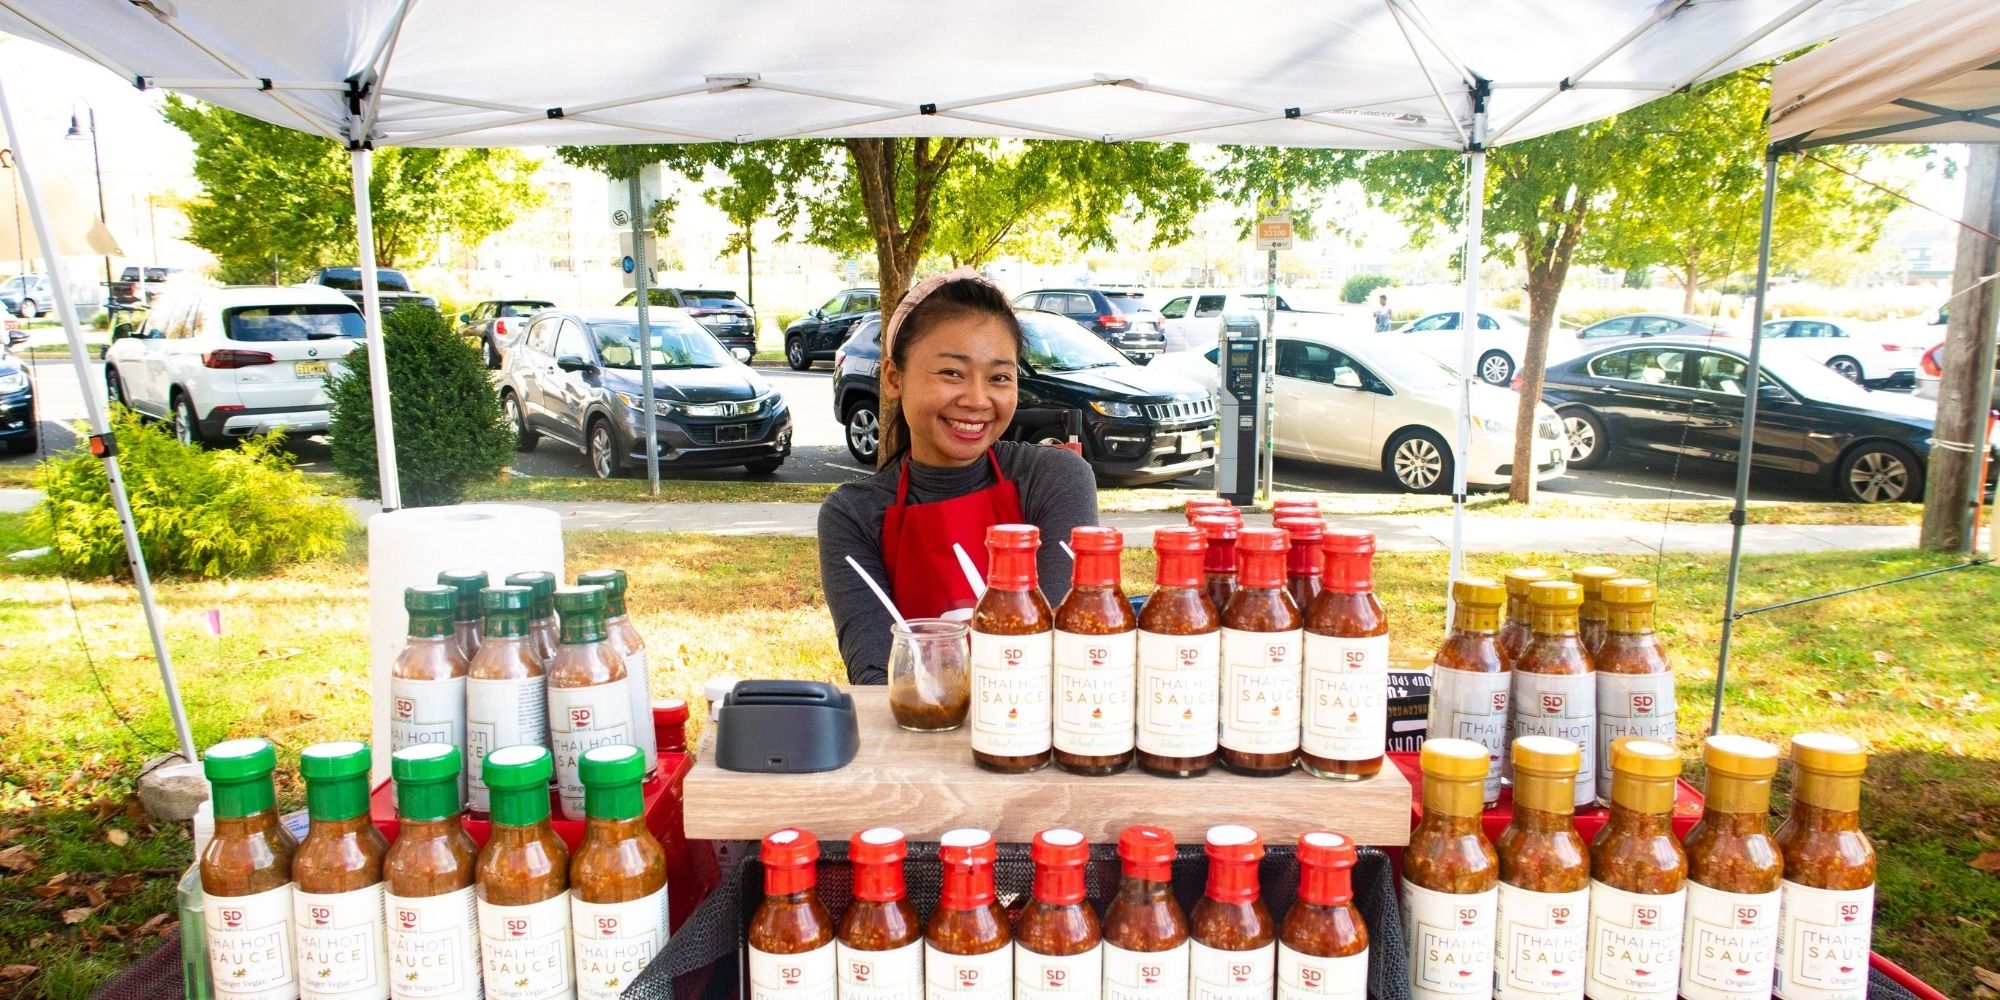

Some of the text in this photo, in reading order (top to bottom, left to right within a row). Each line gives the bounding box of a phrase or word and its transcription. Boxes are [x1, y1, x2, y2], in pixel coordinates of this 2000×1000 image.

[1004, 649, 1022, 659] SD
[1088, 648, 1108, 658] SD
[1180, 650, 1198, 660] SD
[1269, 646, 1286, 656] SD
[1346, 652, 1365, 662] SD
[980, 674, 1012, 689] THAI
[1064, 674, 1097, 689] THAI
[1152, 676, 1188, 689] THAI
[1239, 674, 1276, 688] THAI
[1317, 679, 1354, 692] THAI
[982, 690, 1044, 705] SAUCE
[1065, 690, 1128, 705] SAUCE
[1154, 690, 1216, 706] SAUCE
[1494, 694, 1506, 704] SD
[1543, 696, 1562, 707] SD
[1634, 696, 1653, 707] SD
[398, 700, 412, 712] SD
[1388, 704, 1428, 718] NNERWARE
[571, 710, 590, 720] SD
[1463, 722, 1497, 734] THAI
[1518, 721, 1588, 738] THAI HOT
[1607, 724, 1642, 736] THAI
[408, 732, 441, 743] HOT
[554, 734, 620, 752] THAI HOT
[223, 911, 242, 920] SD
[312, 908, 330, 918] SD
[1459, 909, 1478, 919] SD
[1552, 908, 1570, 918] SD
[1637, 908, 1657, 919] SD
[1737, 908, 1757, 919] SD
[1841, 904, 1858, 915] SD
[400, 911, 416, 922] SD
[508, 920, 526, 930] SD
[598, 918, 618, 928] SD
[241, 932, 277, 948] HOT
[327, 932, 363, 948] HOT
[1427, 934, 1466, 949] THAI
[1518, 932, 1558, 948] THAI
[1604, 928, 1644, 949] THAI
[1702, 930, 1744, 948] THAI
[1804, 930, 1847, 945] THAI
[414, 937, 449, 952] HOT
[486, 940, 557, 960] THAI HOT
[578, 941, 648, 959] THAI HOT
[1606, 945, 1674, 964] SAUCE
[391, 954, 448, 968] AUCE
[490, 956, 556, 974] SAUCE
[582, 957, 646, 974] SAUCE
[782, 968, 802, 978] SD
[852, 963, 870, 975] SD
[960, 970, 978, 980] SD
[1046, 970, 1066, 980] SD
[1142, 966, 1160, 976] SD
[1232, 966, 1251, 976] SD
[1302, 968, 1322, 980] SD
